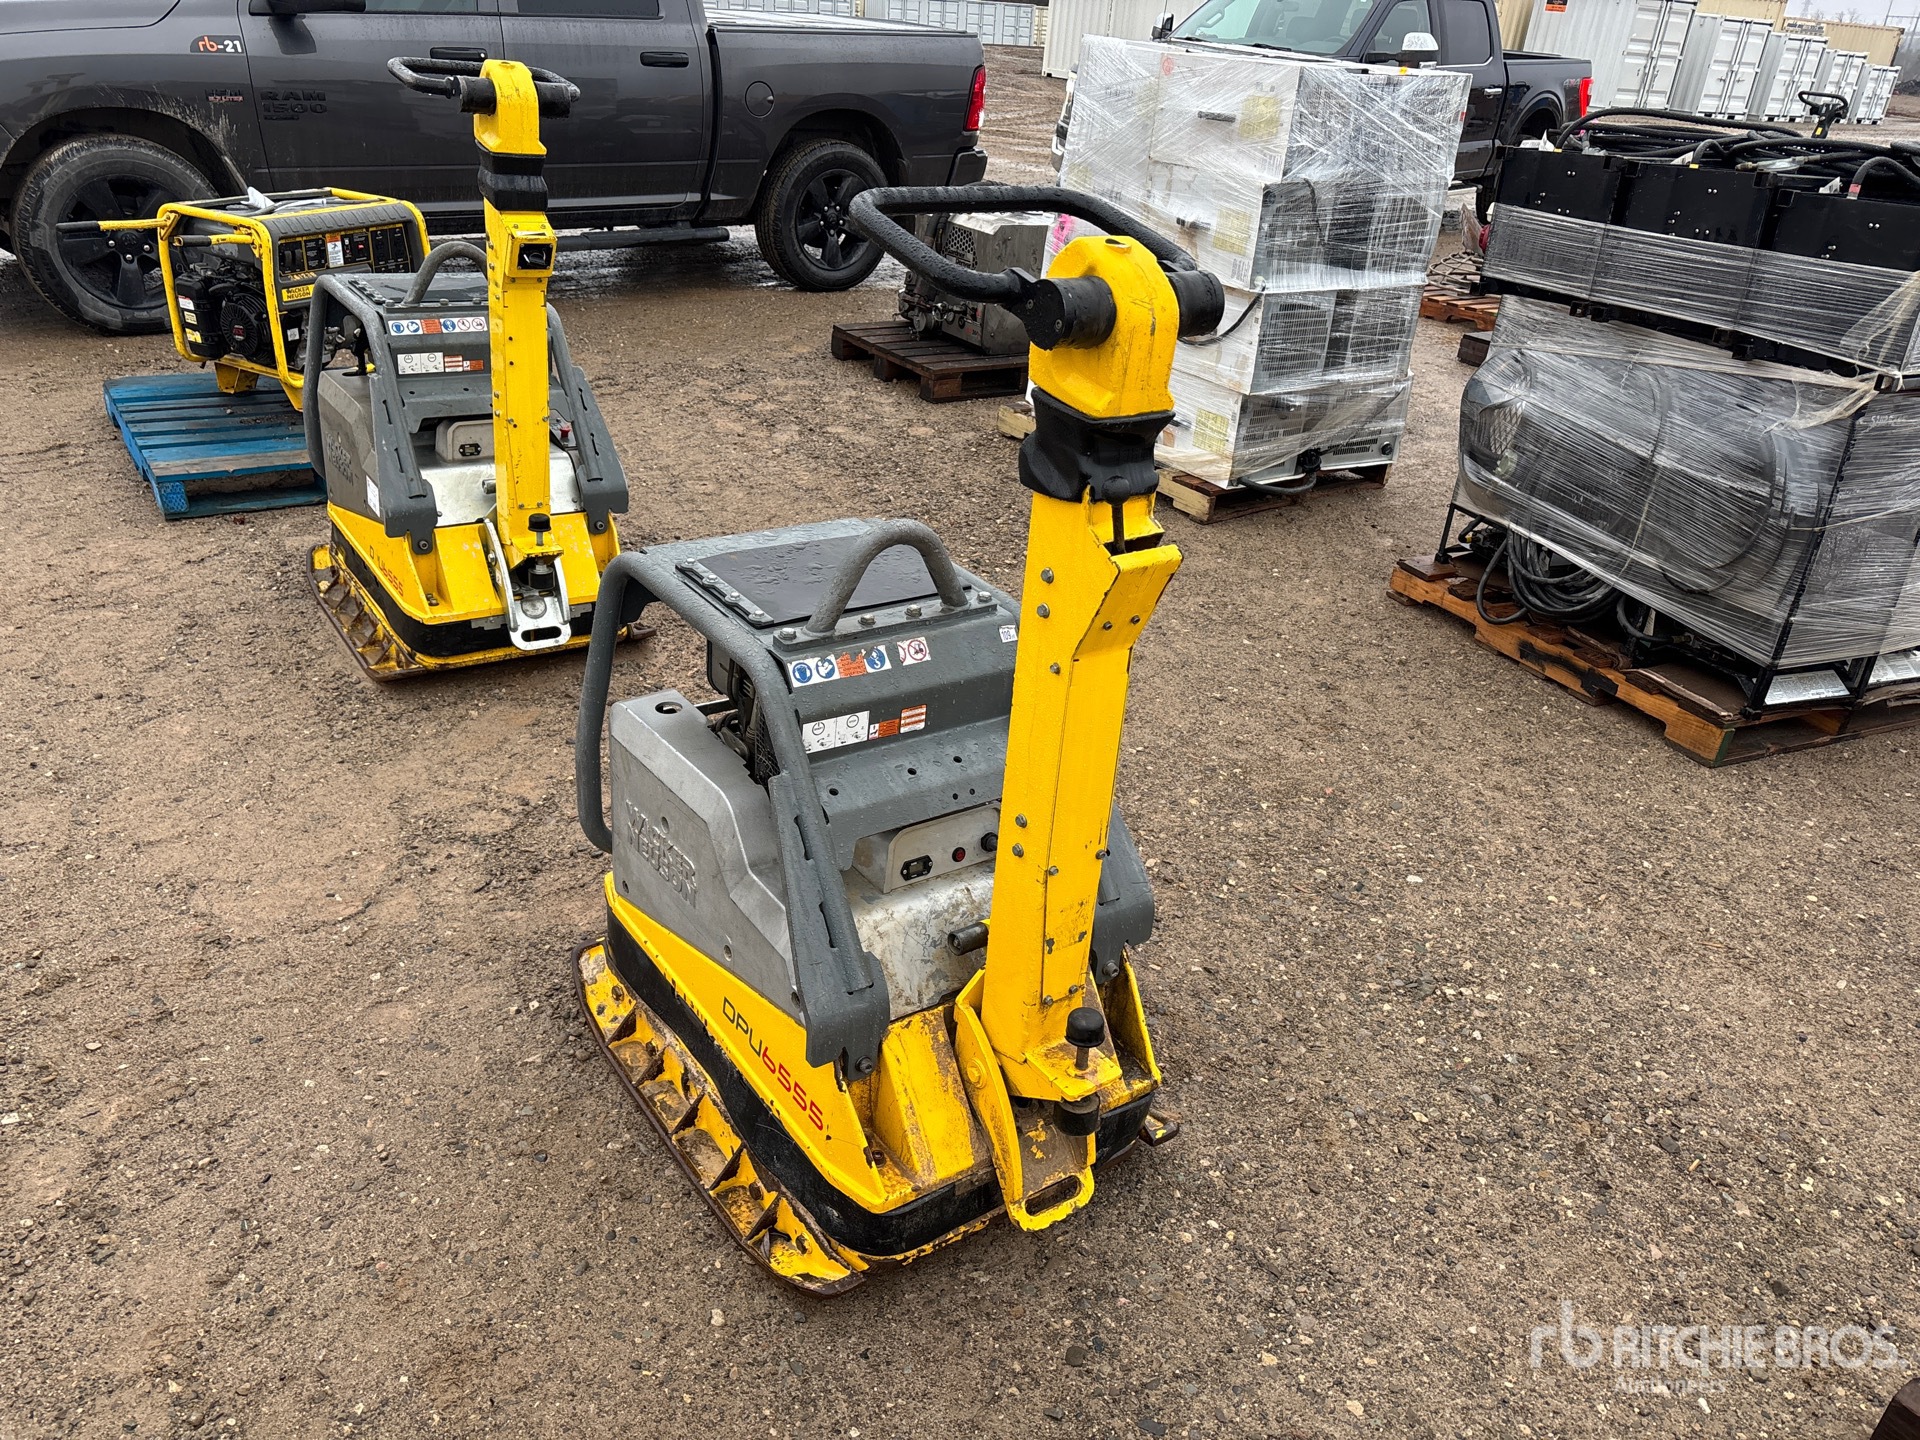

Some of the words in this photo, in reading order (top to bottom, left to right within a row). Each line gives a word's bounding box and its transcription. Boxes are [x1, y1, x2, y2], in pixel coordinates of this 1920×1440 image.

[198, 36, 242, 53] rb-21
[260, 90, 326, 102] RAM
[262, 103, 328, 114] 1500
[285, 286, 310, 294] WACKER
[286, 291, 311, 300] NEUSON
[625, 799, 697, 890] WACKER
[627, 822, 697, 909] NEUSON
[722, 996, 824, 1131] DPU6555
